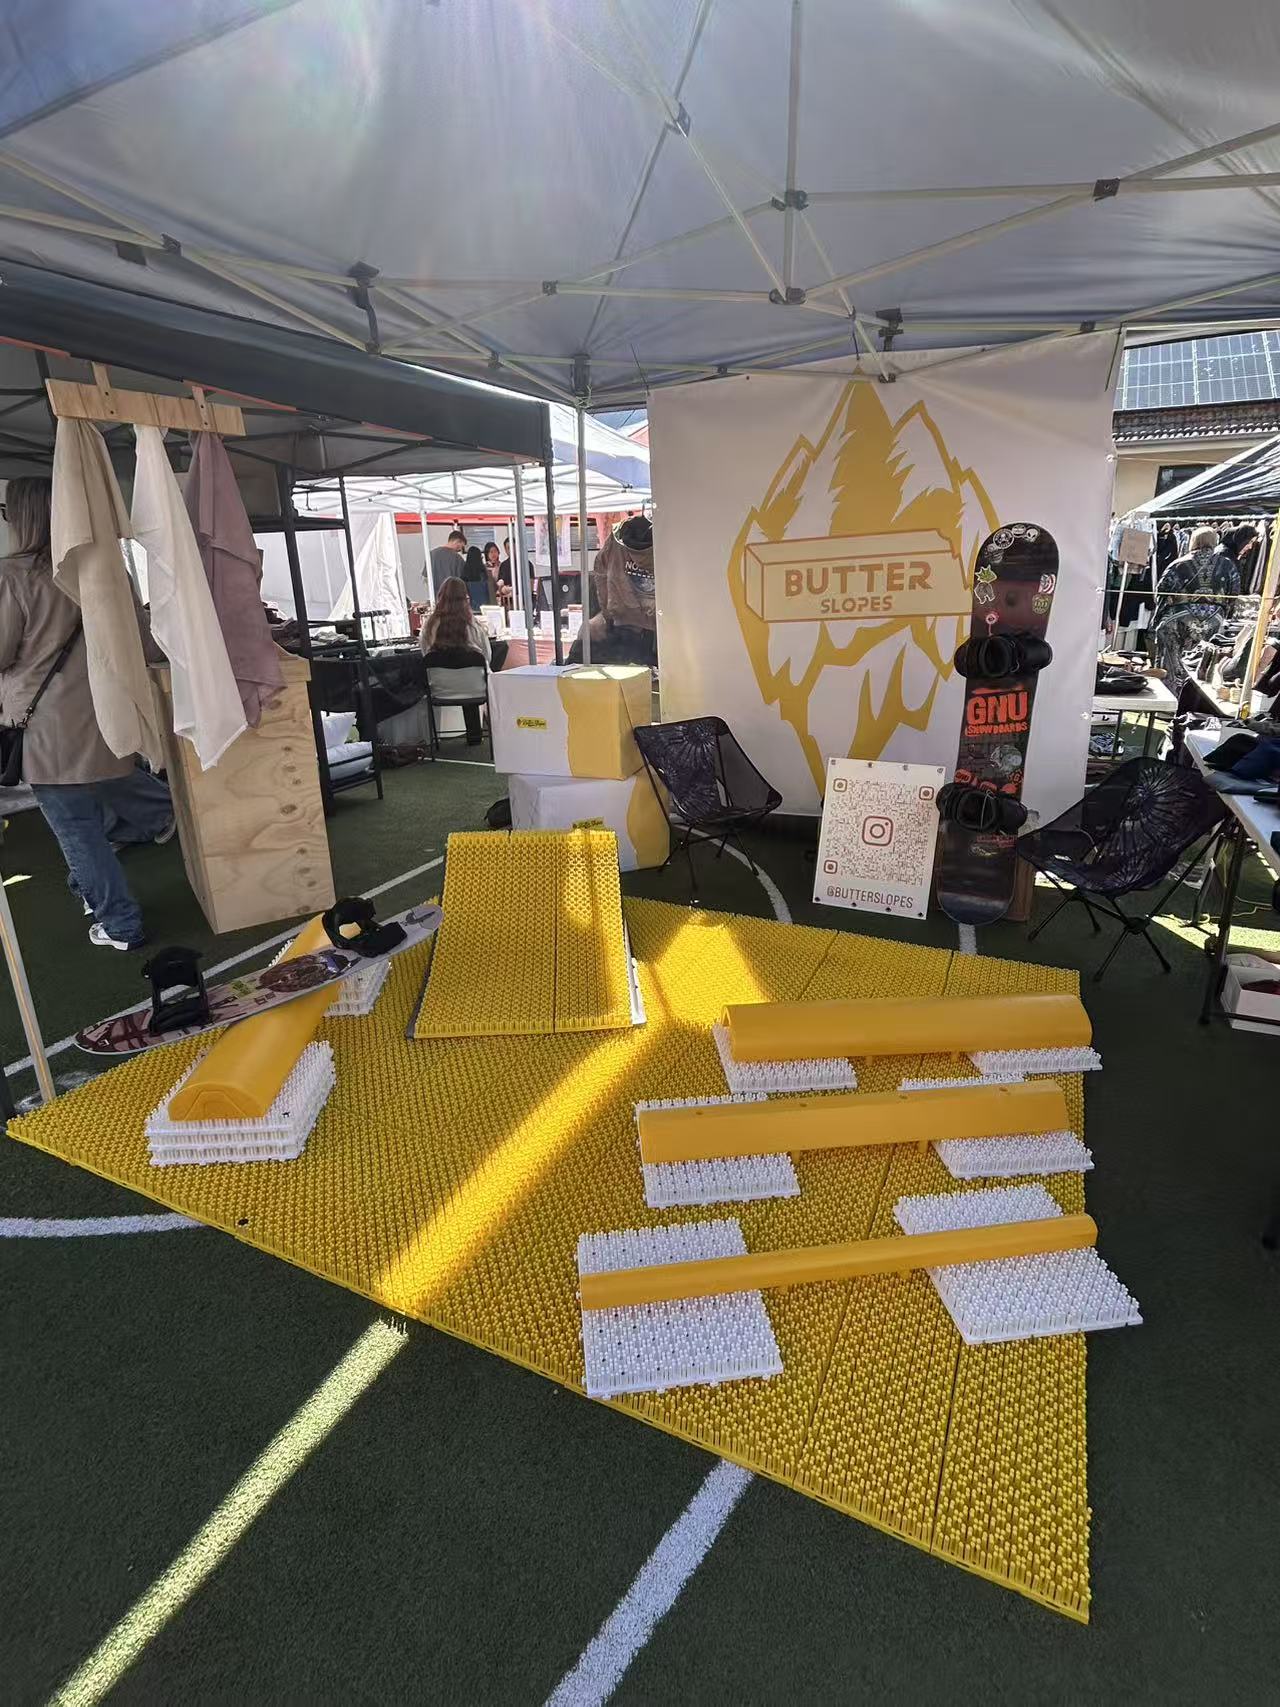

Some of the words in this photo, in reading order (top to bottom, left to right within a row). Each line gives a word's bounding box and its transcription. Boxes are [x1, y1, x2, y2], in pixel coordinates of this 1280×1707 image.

[785, 561, 933, 597] BUTTER
[820, 595, 893, 614] SLOPES
[967, 691, 1028, 725] GNU
[967, 722, 1028, 735] SNOWBOARDS
[826, 885, 914, 909] @BUTTERSLOPES
